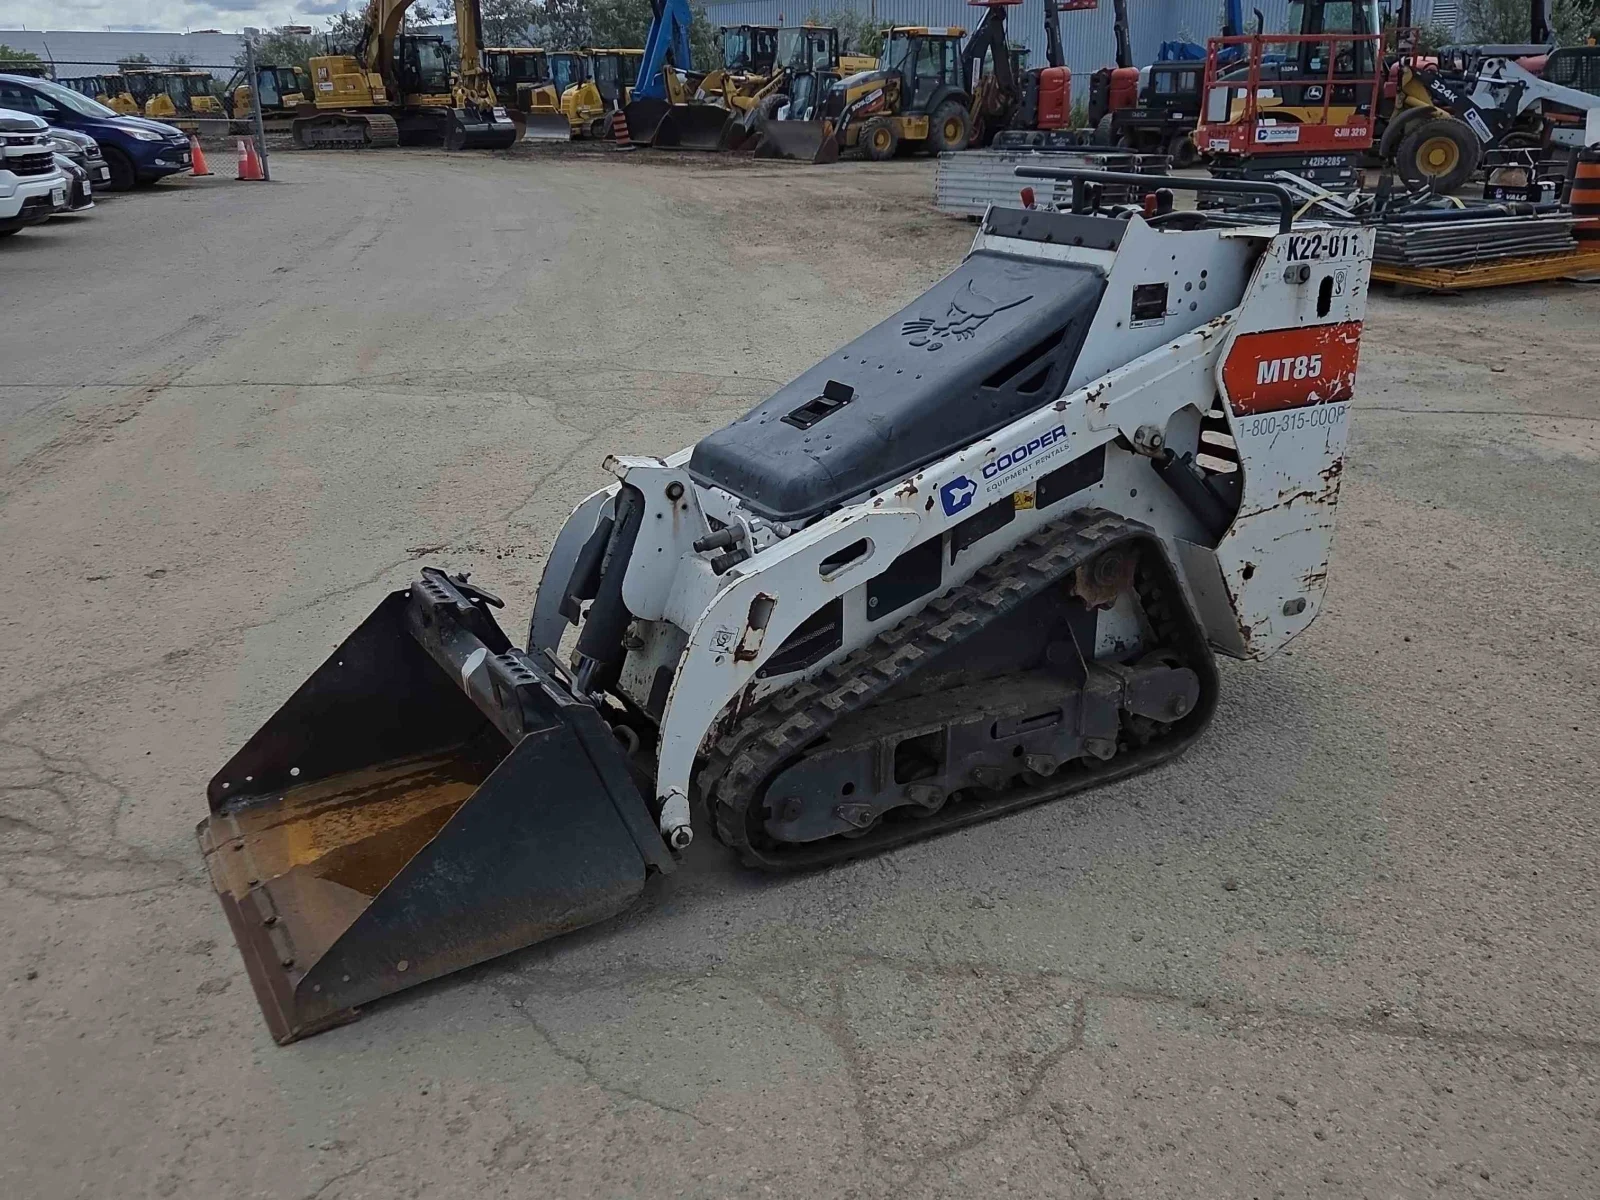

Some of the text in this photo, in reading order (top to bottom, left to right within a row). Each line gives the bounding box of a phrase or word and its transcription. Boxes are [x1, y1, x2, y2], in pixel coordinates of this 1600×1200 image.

[1430, 79, 1458, 103] 324K
[1351, 127, 1367, 137] 3219
[1256, 354, 1322, 385] MT85
[982, 424, 1067, 480] COOPER
[986, 443, 1070, 493] EQUIPMENT RENTALS
